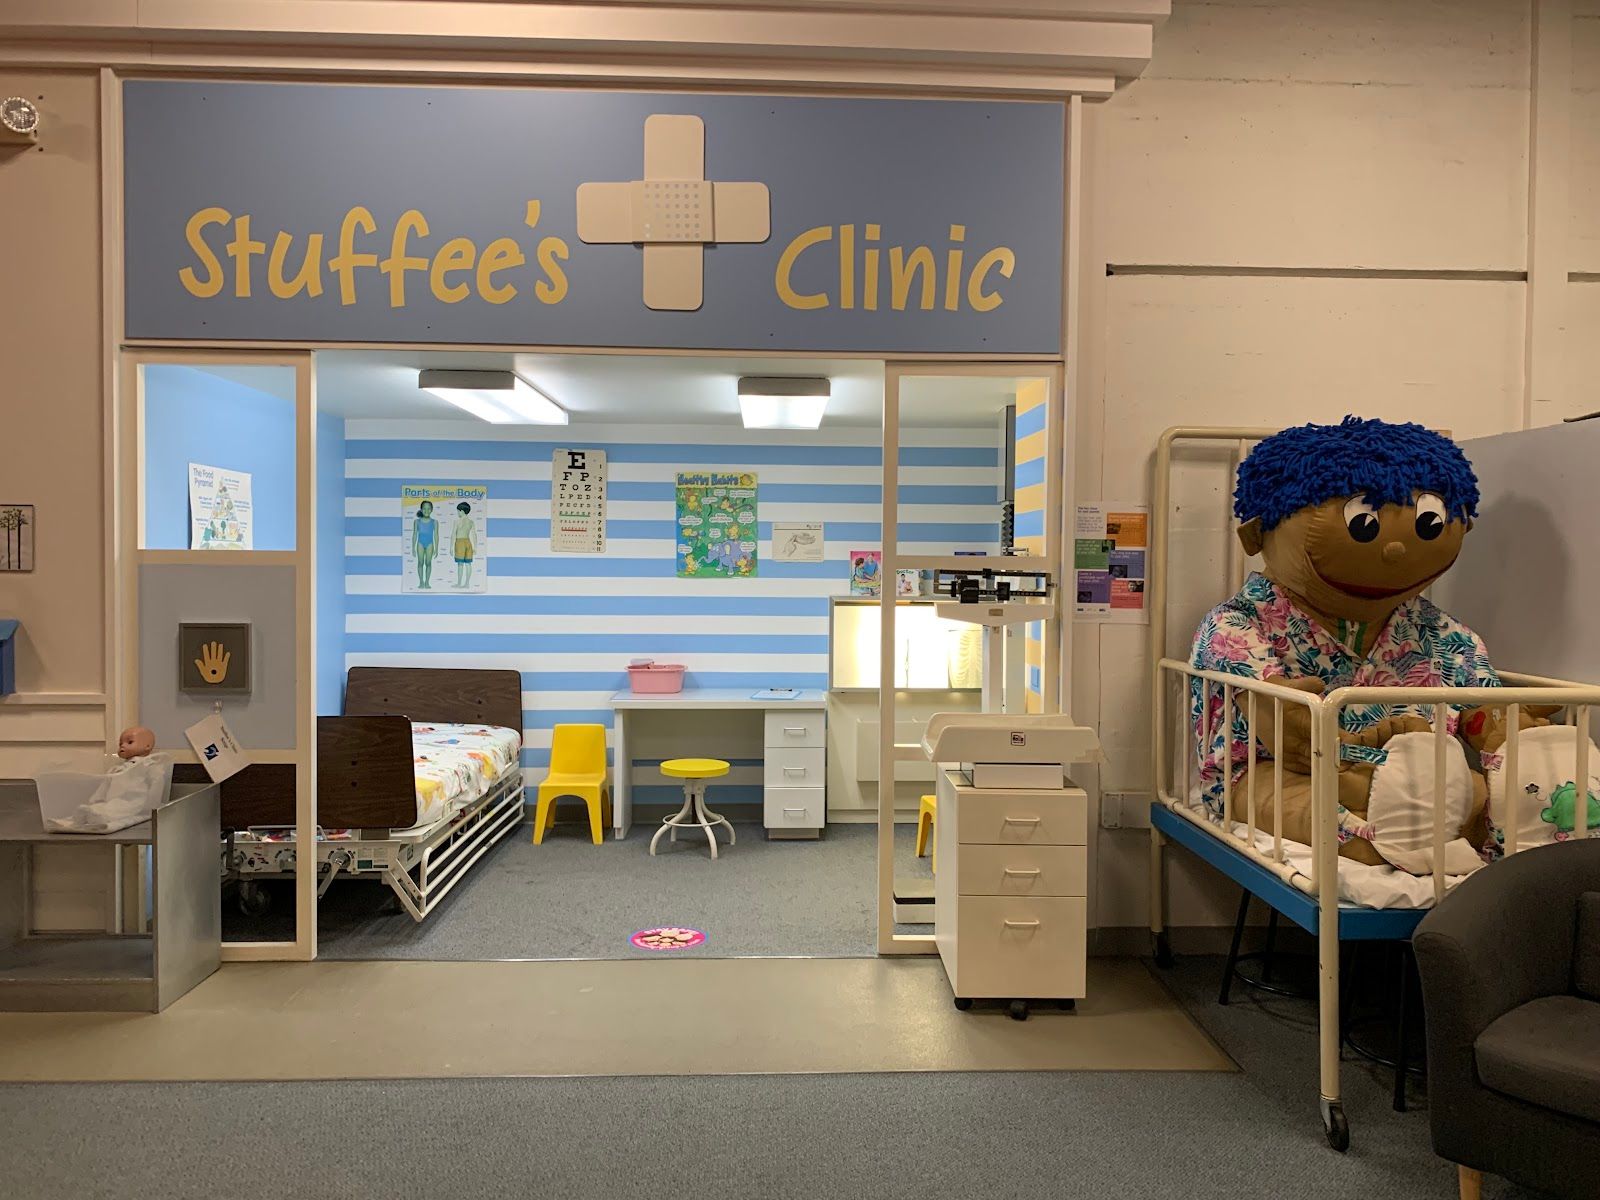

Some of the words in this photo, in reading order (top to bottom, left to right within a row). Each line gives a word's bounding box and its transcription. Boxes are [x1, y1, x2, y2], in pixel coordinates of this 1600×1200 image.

[178, 199, 569, 308] Stuffee's
[775, 223, 1016, 312] Clinic
[567, 451, 585, 470] E
[562, 471, 572, 481] F
[580, 472, 590, 482] P
[404, 487, 431, 498] Parts
[457, 488, 485, 499] Body
